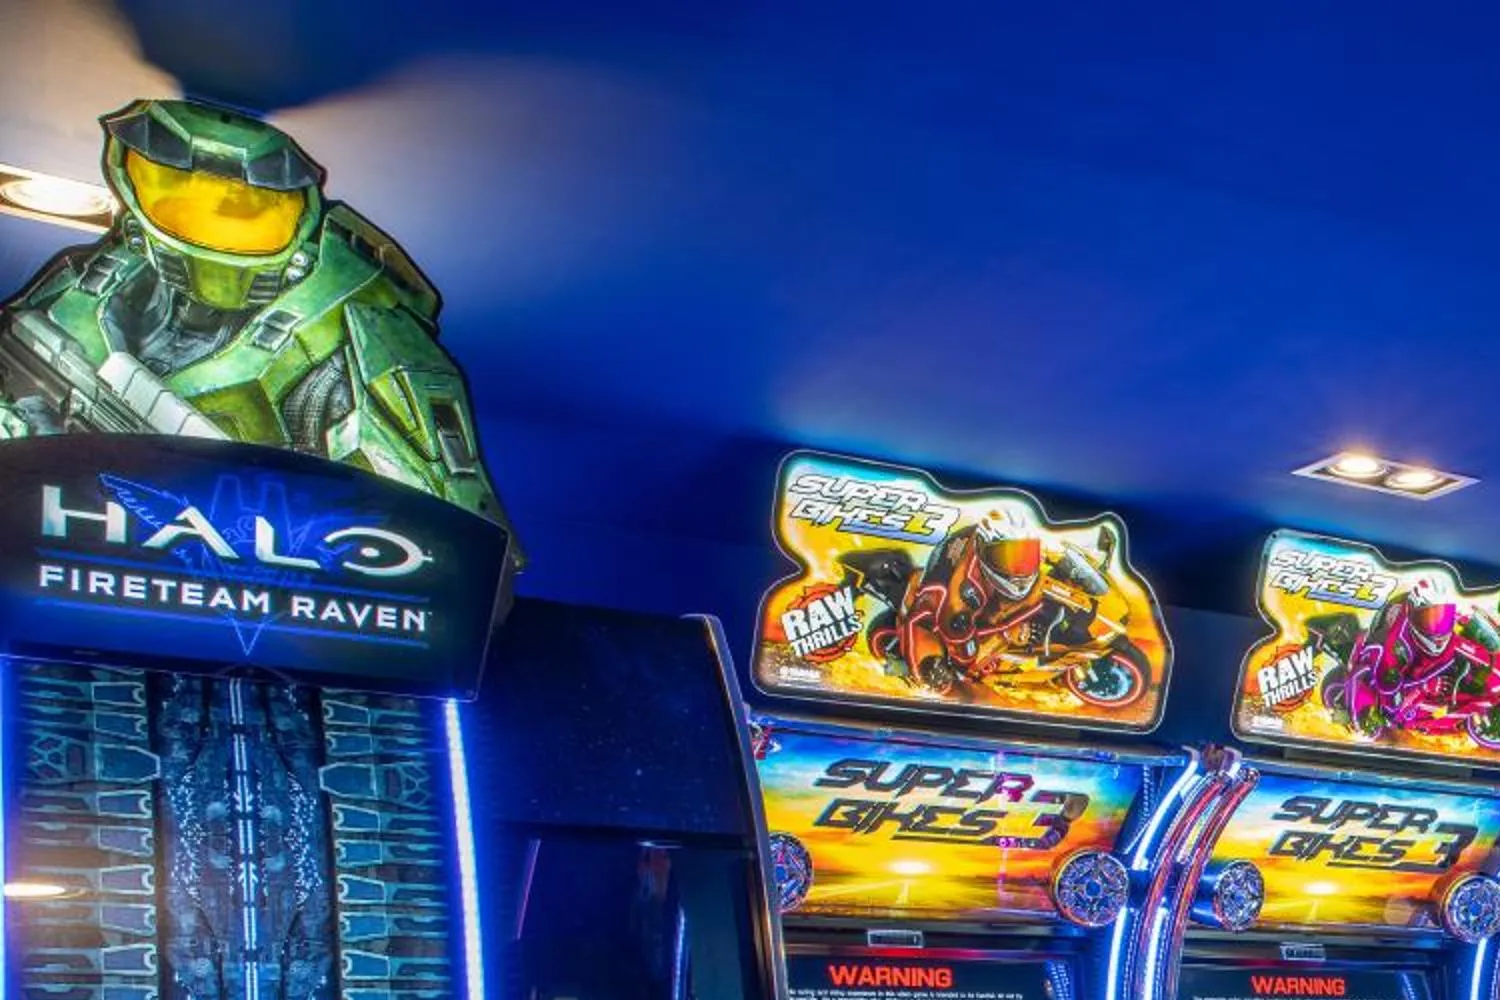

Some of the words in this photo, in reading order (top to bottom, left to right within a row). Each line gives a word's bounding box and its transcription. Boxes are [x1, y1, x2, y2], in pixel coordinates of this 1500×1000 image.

[789, 473, 929, 514] SUPER
[41, 484, 433, 577] HALO
[40, 564, 270, 615] FIRETEAM
[291, 596, 425, 632] RAVEN
[781, 586, 856, 642] RAW
[790, 614, 864, 657] THRILLS
[1257, 645, 1313, 695] RAW
[1263, 672, 1318, 708] THRILLS
[813, 757, 1035, 804] SUPER
[813, 797, 1016, 837] BIKES
[1271, 795, 1438, 834] SUPER
[828, 964, 953, 988] WARNING
[1251, 975, 1346, 996] WARNING
